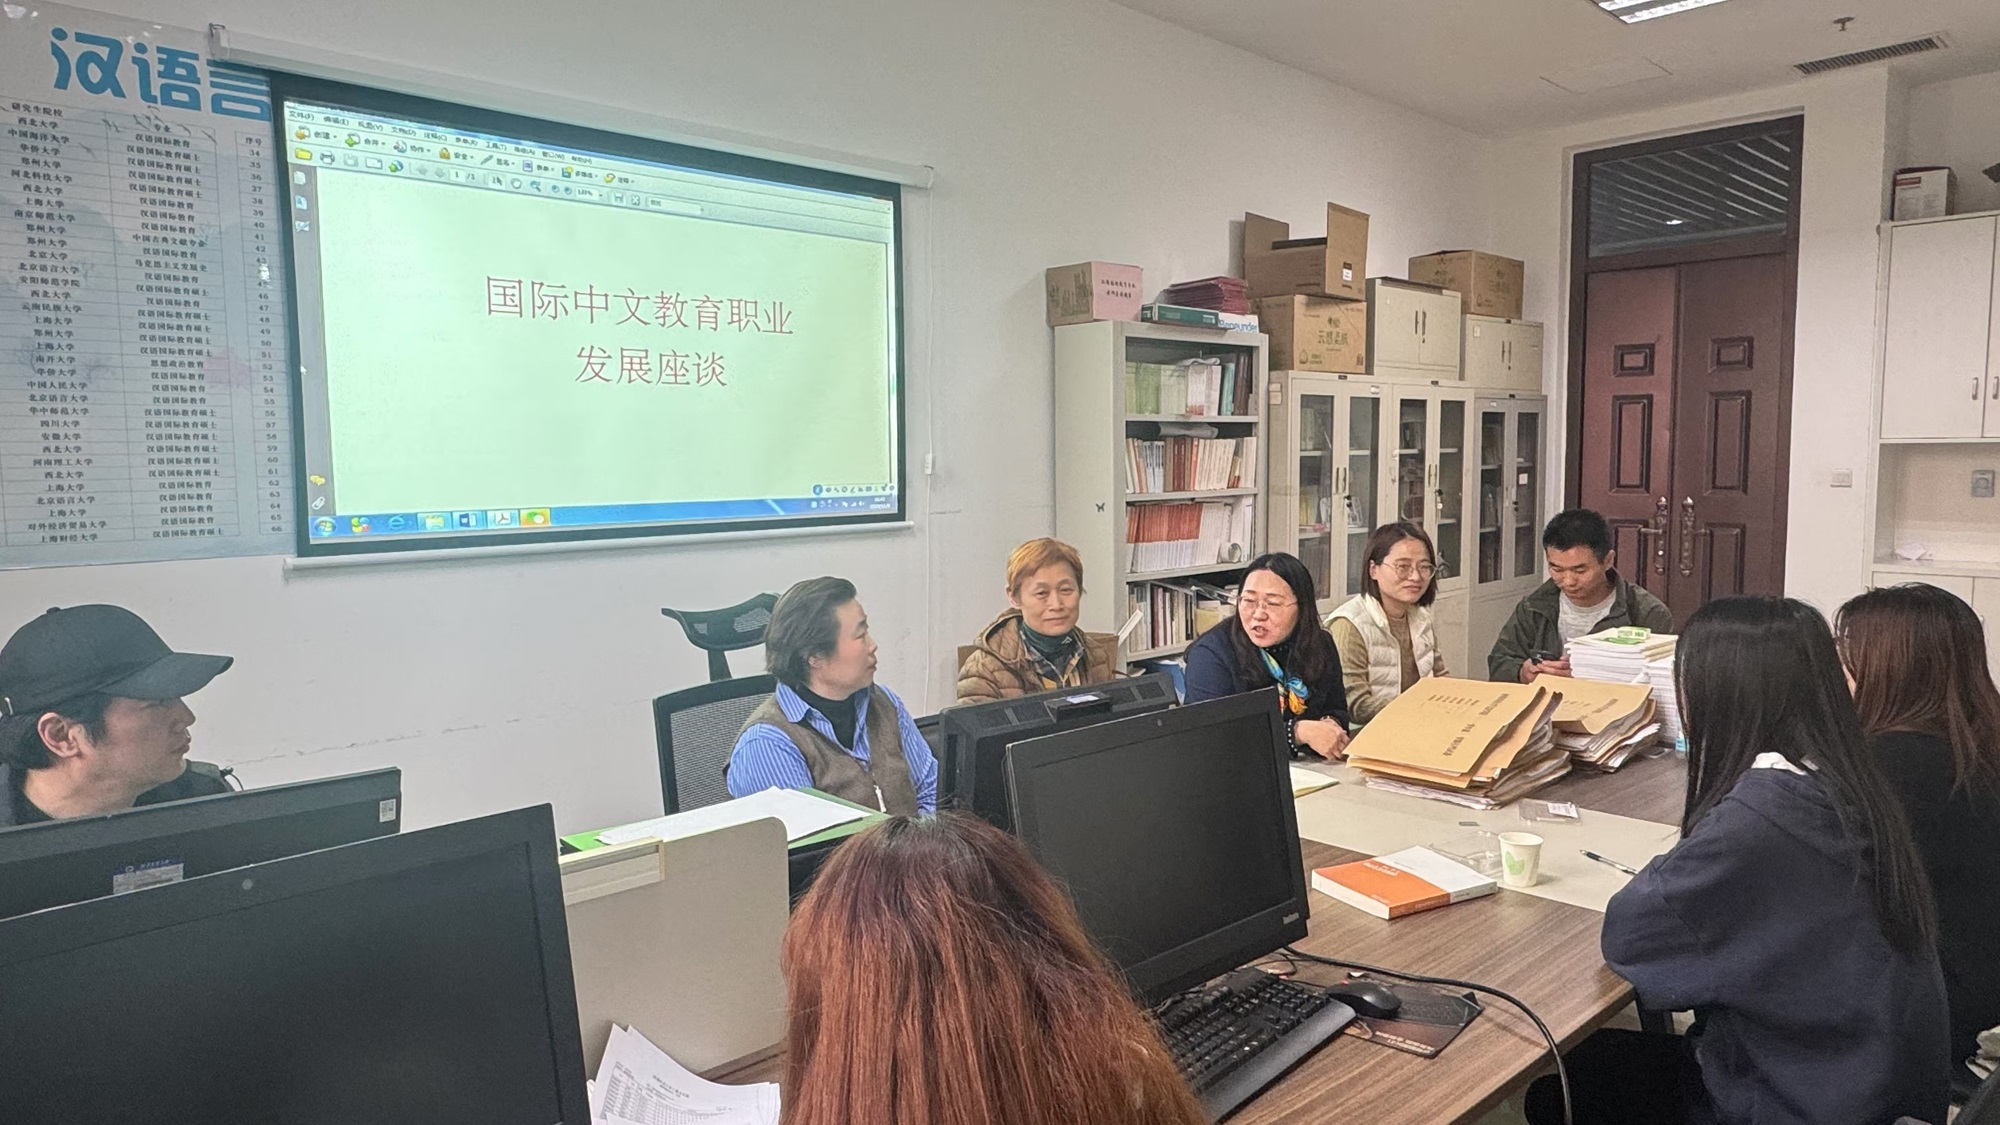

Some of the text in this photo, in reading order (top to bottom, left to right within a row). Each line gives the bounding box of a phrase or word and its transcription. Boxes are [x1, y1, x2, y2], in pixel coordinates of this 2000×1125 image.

[50, 27, 272, 122] 汉语言
[12, 102, 170, 132] 研究生院校 专业
[18, 117, 190, 148] 西北大学 汉语国际教育
[8, 129, 200, 161] 中国海洋大学 汉语国际教育硕士
[246, 137, 262, 146] 序号
[20, 143, 200, 173] 华侨大学 汉语国际教育硕士
[22, 157, 200, 186] 郑州大学 汉语国际教育硕士
[11, 169, 202, 198] 河北科技大学 汉语国际教育硕士
[23, 184, 194, 210] 西北大学 汉语国际教育
[26, 197, 194, 222] 上海大学 汉语国际教育
[14, 210, 196, 234] 南京师范大学 汉语国际教育
[26, 224, 66, 234] 郑州大学
[26, 237, 197, 259] 郑州大学 汉语国际教育
[28, 250, 68, 260] 北京大学
[18, 262, 199, 283] 北京语言大学 汉语国际教育
[136, 284, 208, 296] 汉语国际教育硕士
[30, 290, 200, 308] 西北大学 汉语国际教育
[486, 276, 794, 335] 国际中文教育职业
[138, 310, 210, 320] 汉语国际教育硕士
[35, 316, 211, 332] 上海大学 汉语国际教育硕士
[34, 328, 212, 345] 郑州大学 汉语国际教育硕士
[36, 342, 212, 357] 上海大学 汉语国际教育硕士
[36, 356, 76, 364] 南开大学
[575, 345, 728, 388] 发展座谈
[36, 368, 204, 380] 华侨大学 汉语国际教育
[27, 381, 205, 392] 中国人民大学 汉语国际教育
[28, 394, 88, 402] 北京语言大学
[29, 407, 216, 417] 华中师范大学 汉语国际教育硕士
[40, 420, 217, 429] 四川大学 汉语国际教育硕士
[42, 446, 82, 454] 西北大学
[33, 457, 219, 466] 河南理工大学 汉语国际教育硕士
[44, 470, 220, 479] 西北大学 汉语国际教育硕士
[48, 482, 212, 492] 上海大学 汉语国际教育
[37, 493, 212, 504] 北京语言大学 汉语国际教育
[50, 505, 213, 517] 上海大学 汉语国际教育
[161, 517, 214, 526] 汉语国际教育
[42, 528, 223, 544] 上海财经大学 汉语国际教育硕士
